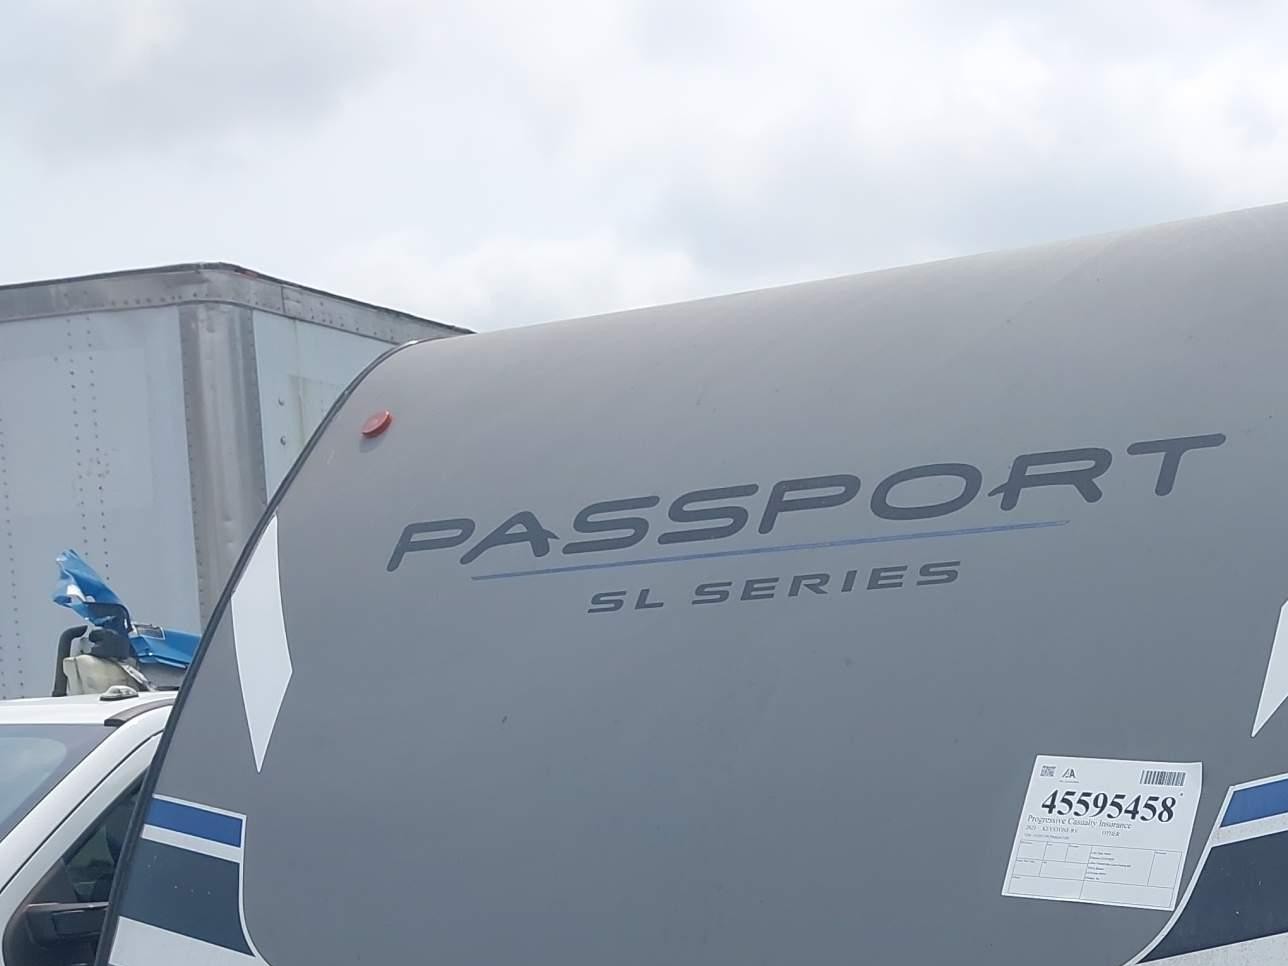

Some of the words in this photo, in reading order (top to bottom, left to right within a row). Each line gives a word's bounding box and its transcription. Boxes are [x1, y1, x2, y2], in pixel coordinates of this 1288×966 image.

[386, 433, 1227, 573] PASSPORT
[587, 588, 666, 614] SL
[691, 561, 961, 605] SERIES
[1027, 814, 1067, 825] Progressive
[1067, 817, 1098, 827] Casualty
[1098, 819, 1132, 829] Insurance
[1041, 789, 1177, 823] 45595458
